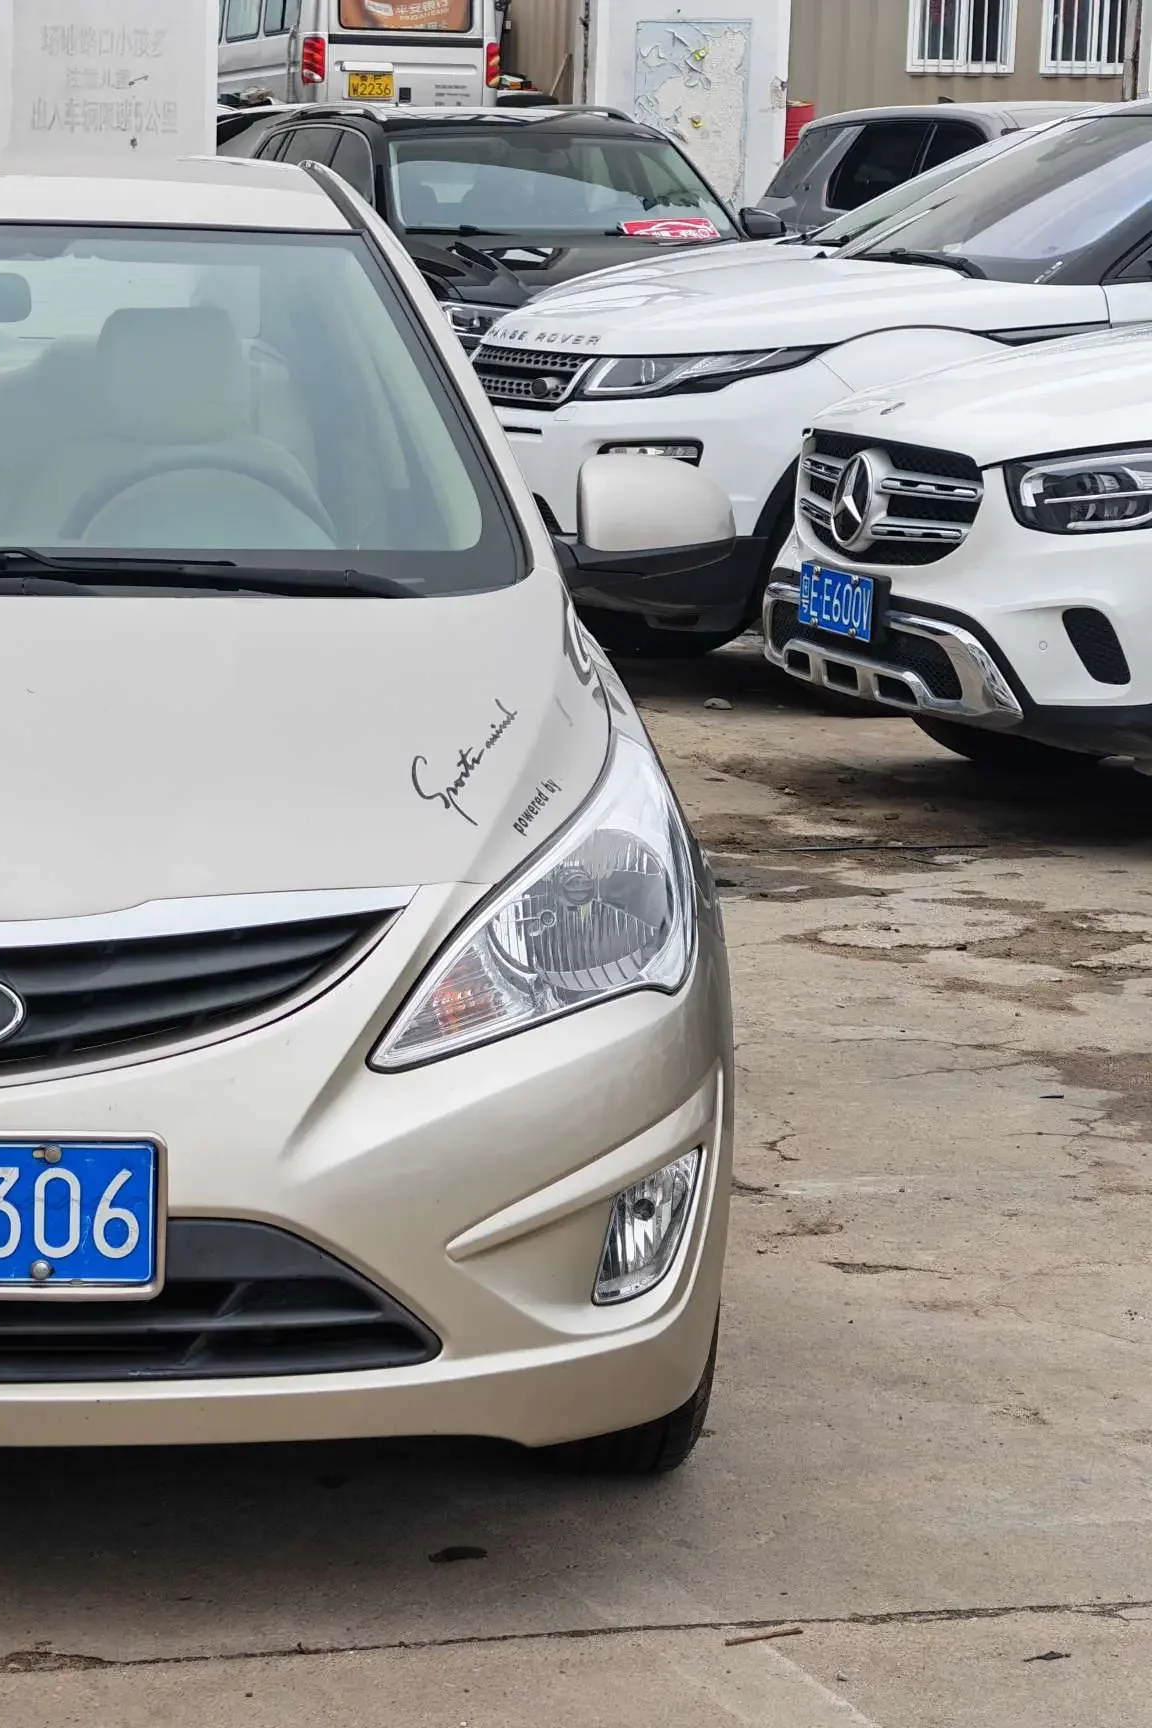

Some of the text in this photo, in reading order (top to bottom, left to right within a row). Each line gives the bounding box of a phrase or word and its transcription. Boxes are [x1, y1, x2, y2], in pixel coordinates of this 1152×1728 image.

[352, 82, 391, 96] W2236
[535, 332, 602, 345] ROVER
[513, 779, 562, 837] powered by
